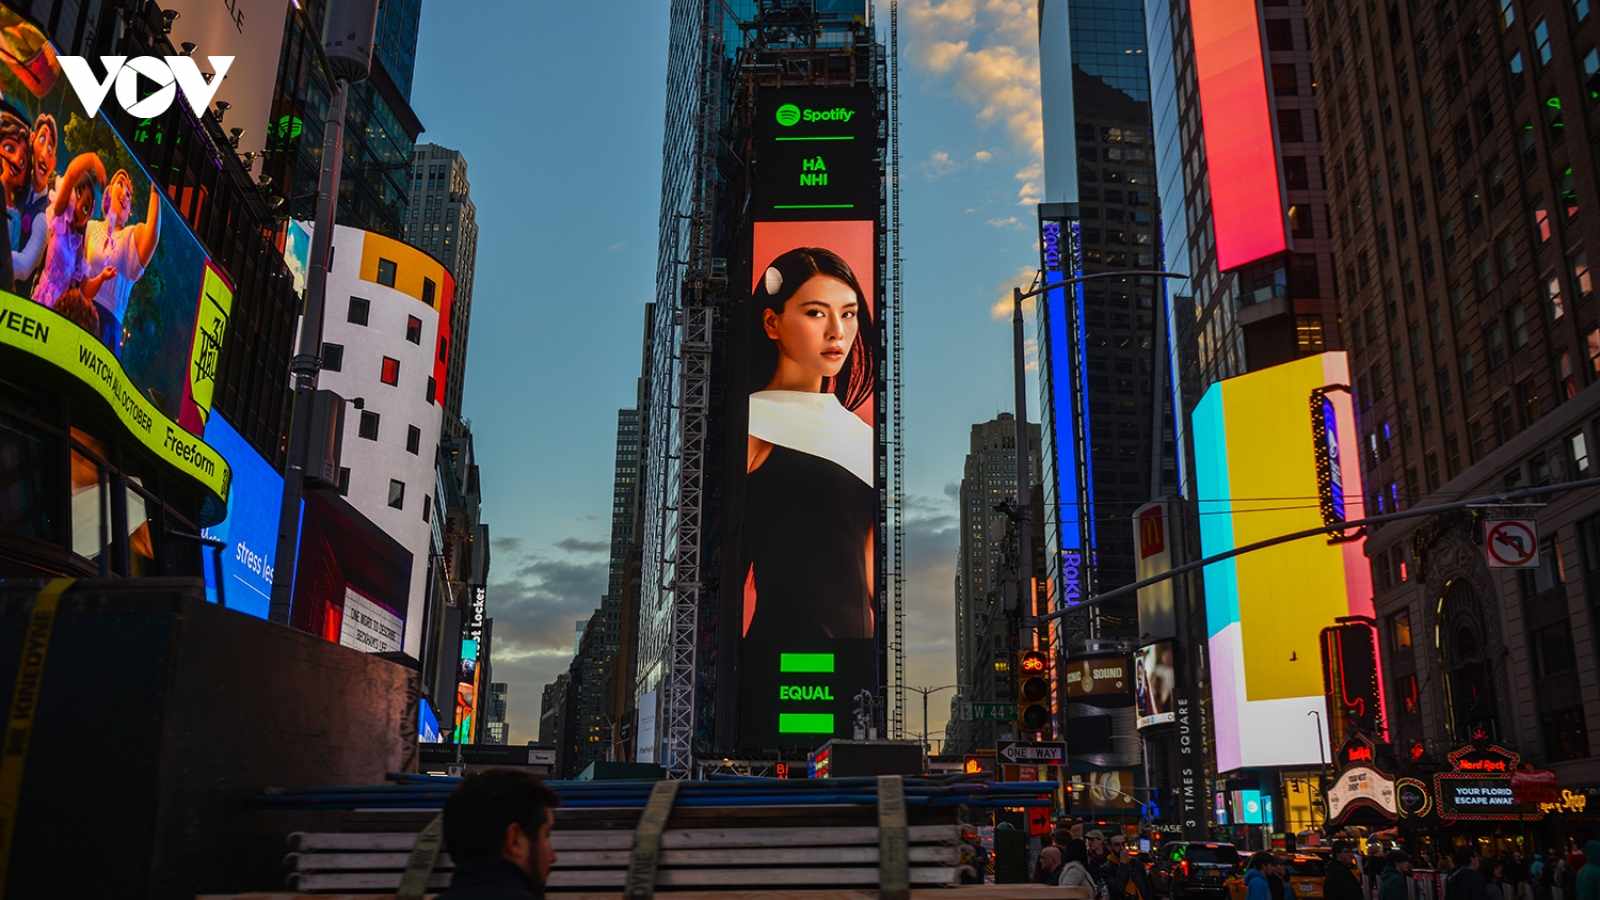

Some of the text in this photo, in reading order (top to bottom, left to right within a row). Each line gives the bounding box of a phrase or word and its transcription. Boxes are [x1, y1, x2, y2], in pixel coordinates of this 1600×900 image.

[803, 108, 853, 122] Spotify
[803, 156, 826, 171] HÀ
[800, 173, 828, 186] NHI
[79, 344, 215, 477] WATCH ALL OCTOBER Freeform
[236, 541, 262, 575] stress
[471, 587, 485, 628] Locker
[14, 610, 51, 721] KINEDYNE
[1093, 667, 1122, 680] SOUND
[780, 685, 834, 700] EQUAL
[974, 705, 985, 718] W
[990, 705, 1005, 718] 44
[1007, 747, 1057, 758] ONE WAY
[1178, 698, 1196, 827] 3 TIMES SQUARE
[1459, 759, 1506, 772] Hard Rock
[1456, 787, 1480, 795] YOUR
[1455, 797, 1488, 805] ESCAPE
